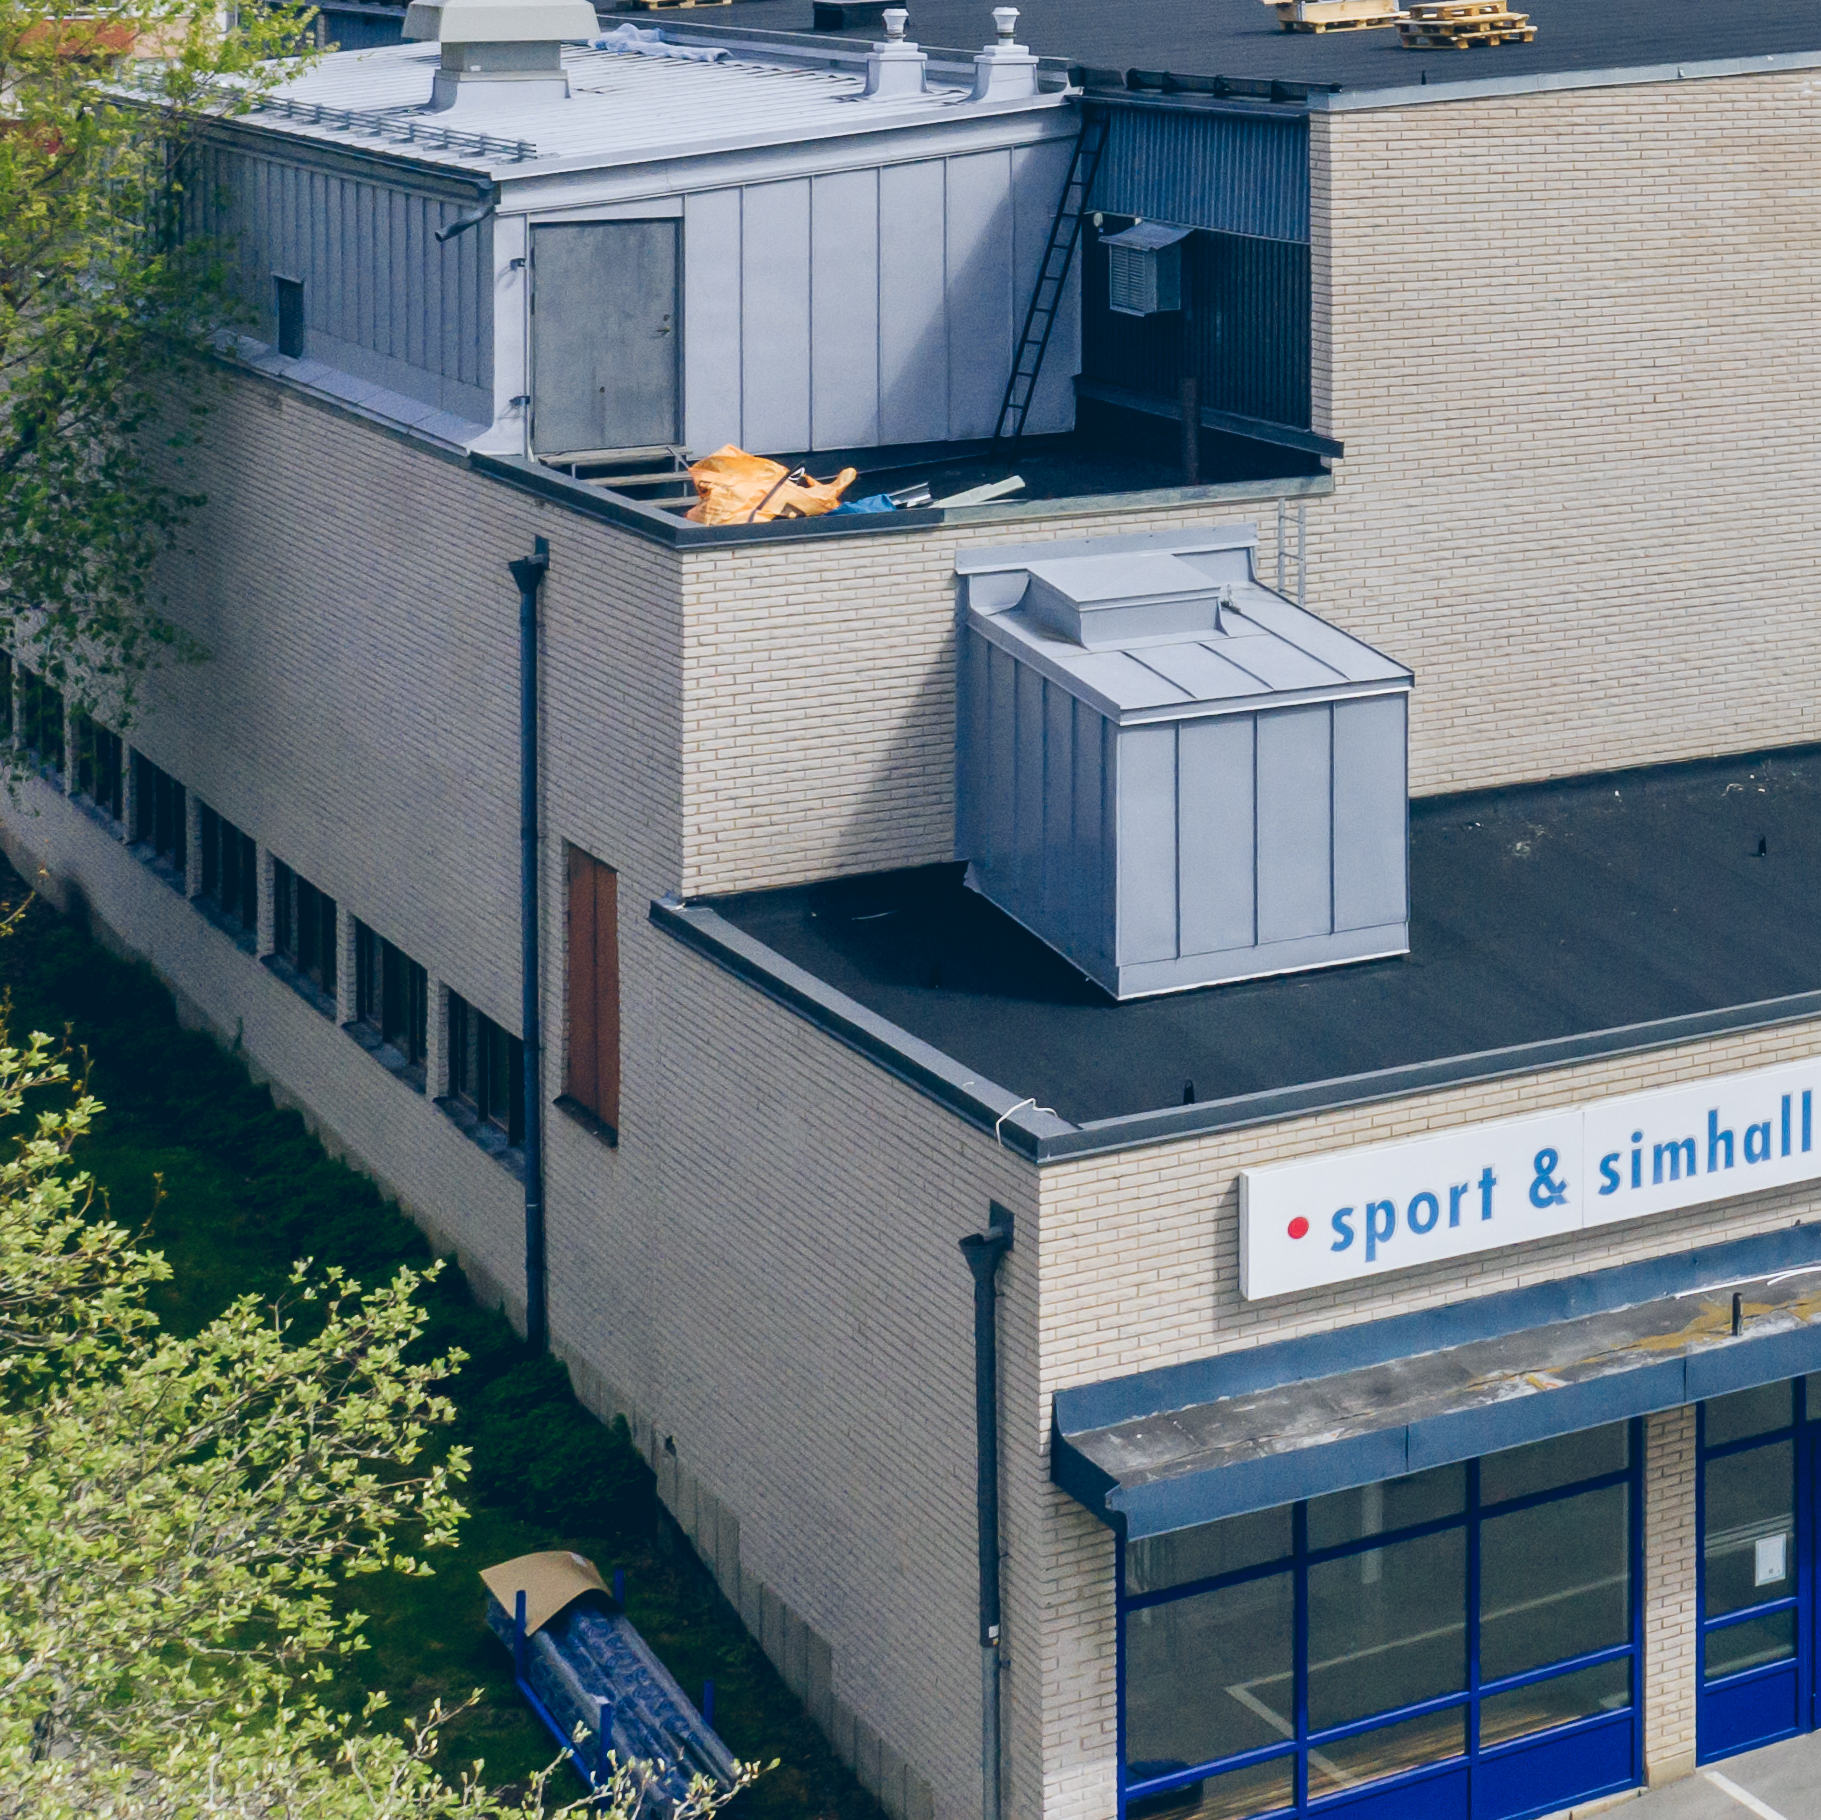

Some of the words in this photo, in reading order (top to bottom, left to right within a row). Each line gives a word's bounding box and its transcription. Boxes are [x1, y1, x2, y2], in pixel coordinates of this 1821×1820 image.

[1330, 1166, 1497, 1263] sport
[1529, 1147, 1568, 1210] &
[1597, 1089, 1814, 1197] simhall
